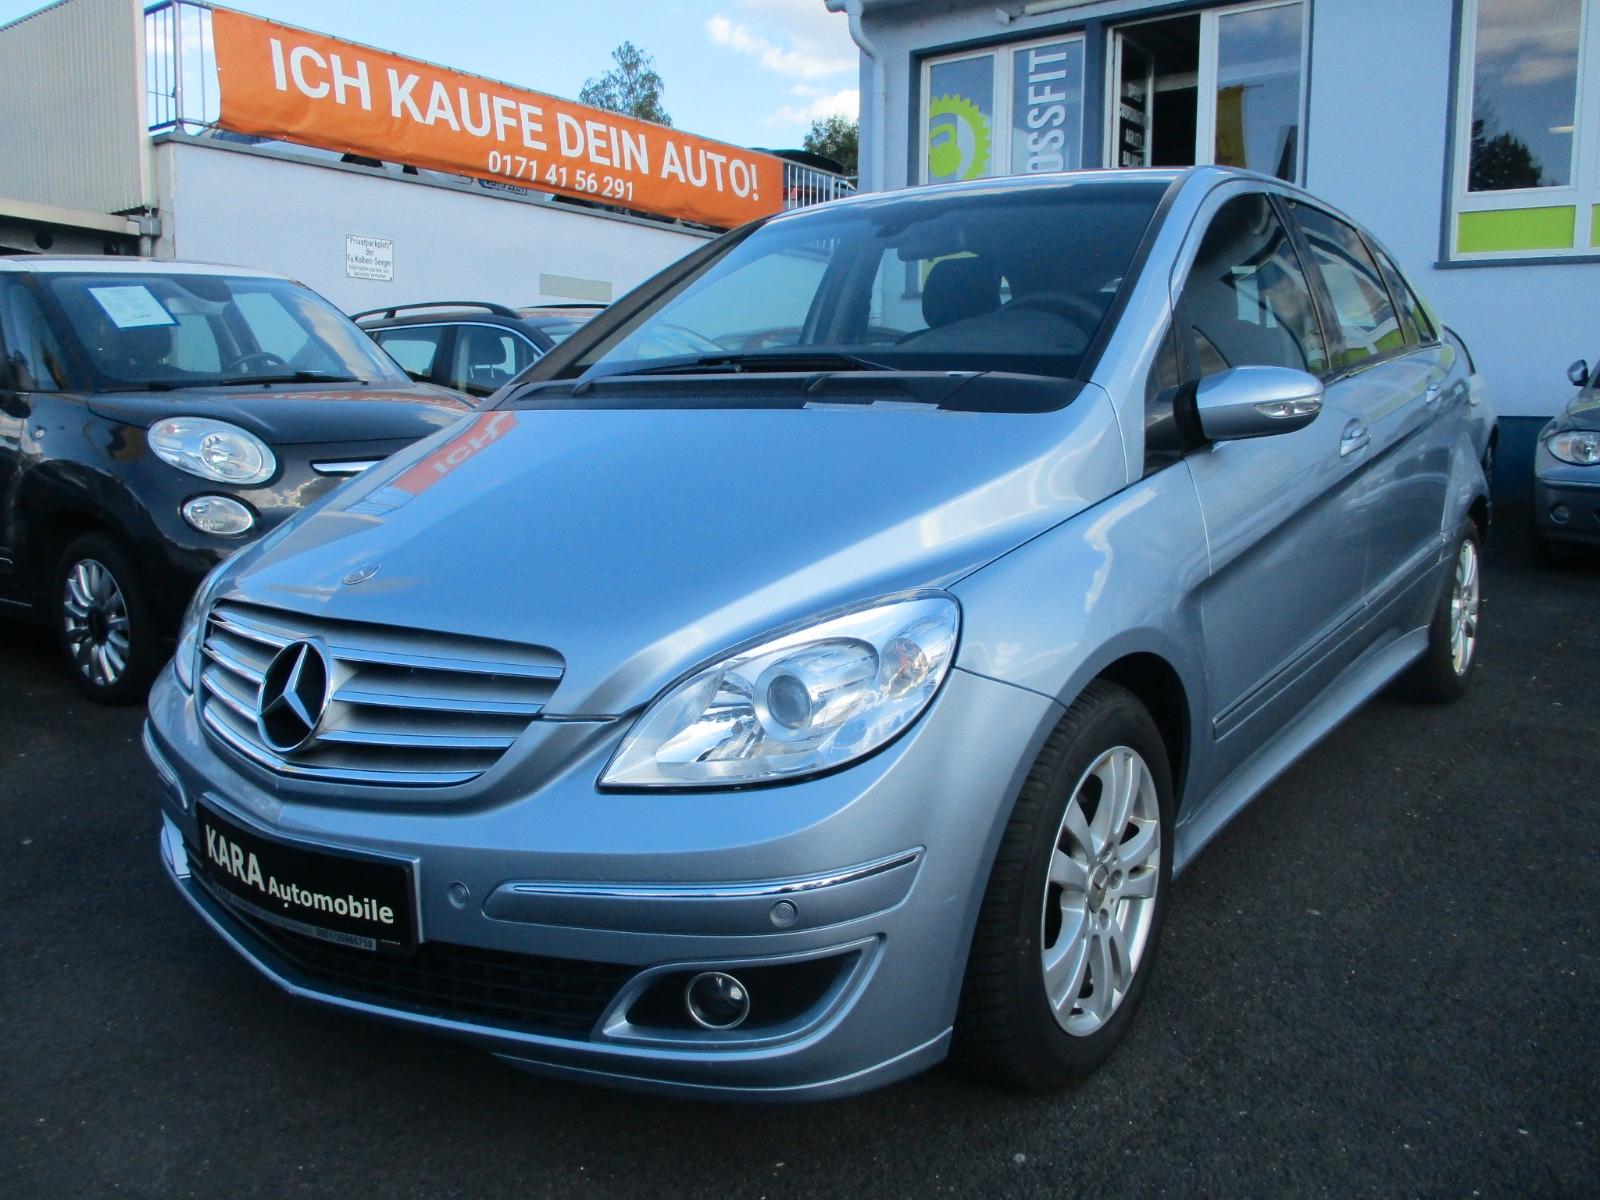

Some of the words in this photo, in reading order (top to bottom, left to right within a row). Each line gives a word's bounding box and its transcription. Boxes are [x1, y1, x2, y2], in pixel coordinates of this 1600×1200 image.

[270, 38, 372, 111] ICH
[386, 68, 548, 151] KAUFE
[556, 112, 650, 175] DEIN
[661, 140, 760, 200] AUTO!
[488, 150, 537, 182] 0171
[544, 164, 568, 187] 41
[574, 169, 598, 193] 56
[601, 175, 633, 200] 291
[205, 824, 265, 892] KARA
[268, 876, 394, 925] Automobile
